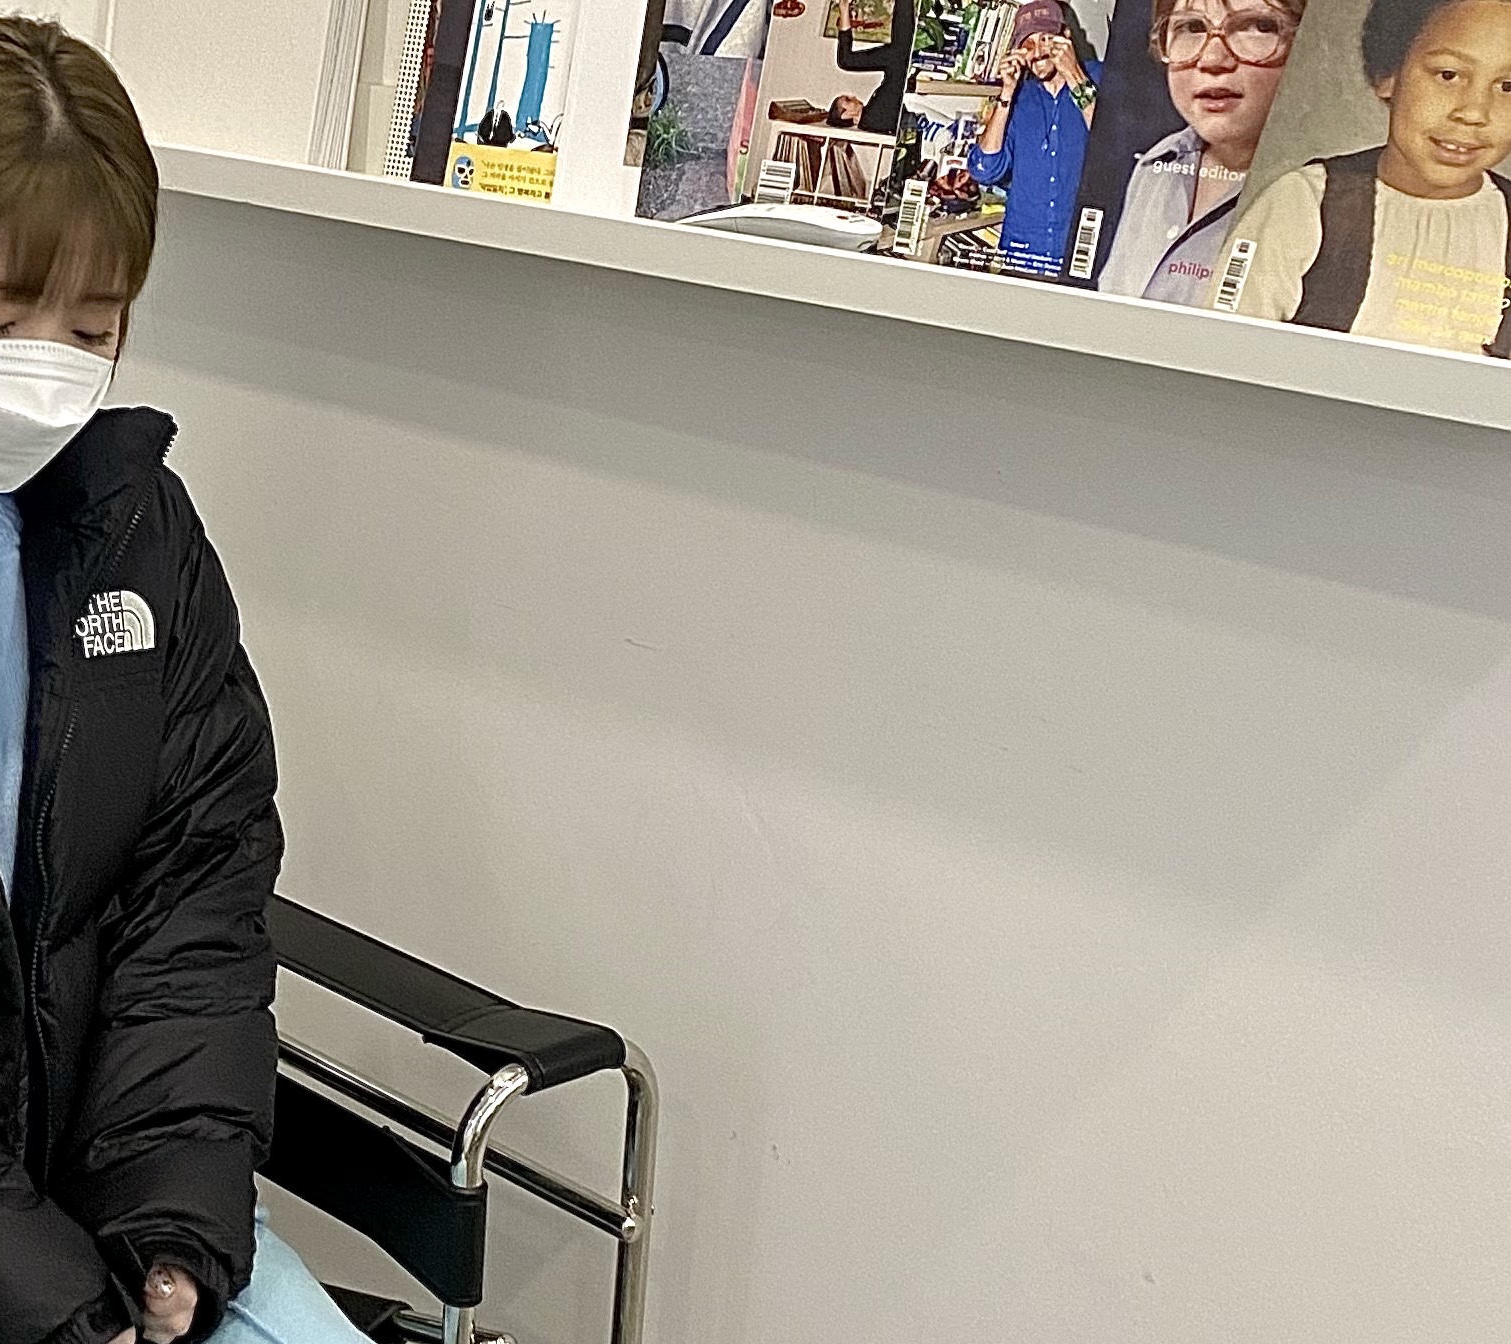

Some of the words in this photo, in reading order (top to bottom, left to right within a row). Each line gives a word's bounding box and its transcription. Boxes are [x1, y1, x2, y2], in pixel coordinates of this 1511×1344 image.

[1152, 159, 1195, 176] guest
[1199, 164, 1247, 182] editor
[75, 612, 124, 638] ORTH
[83, 631, 125, 659] FACE
